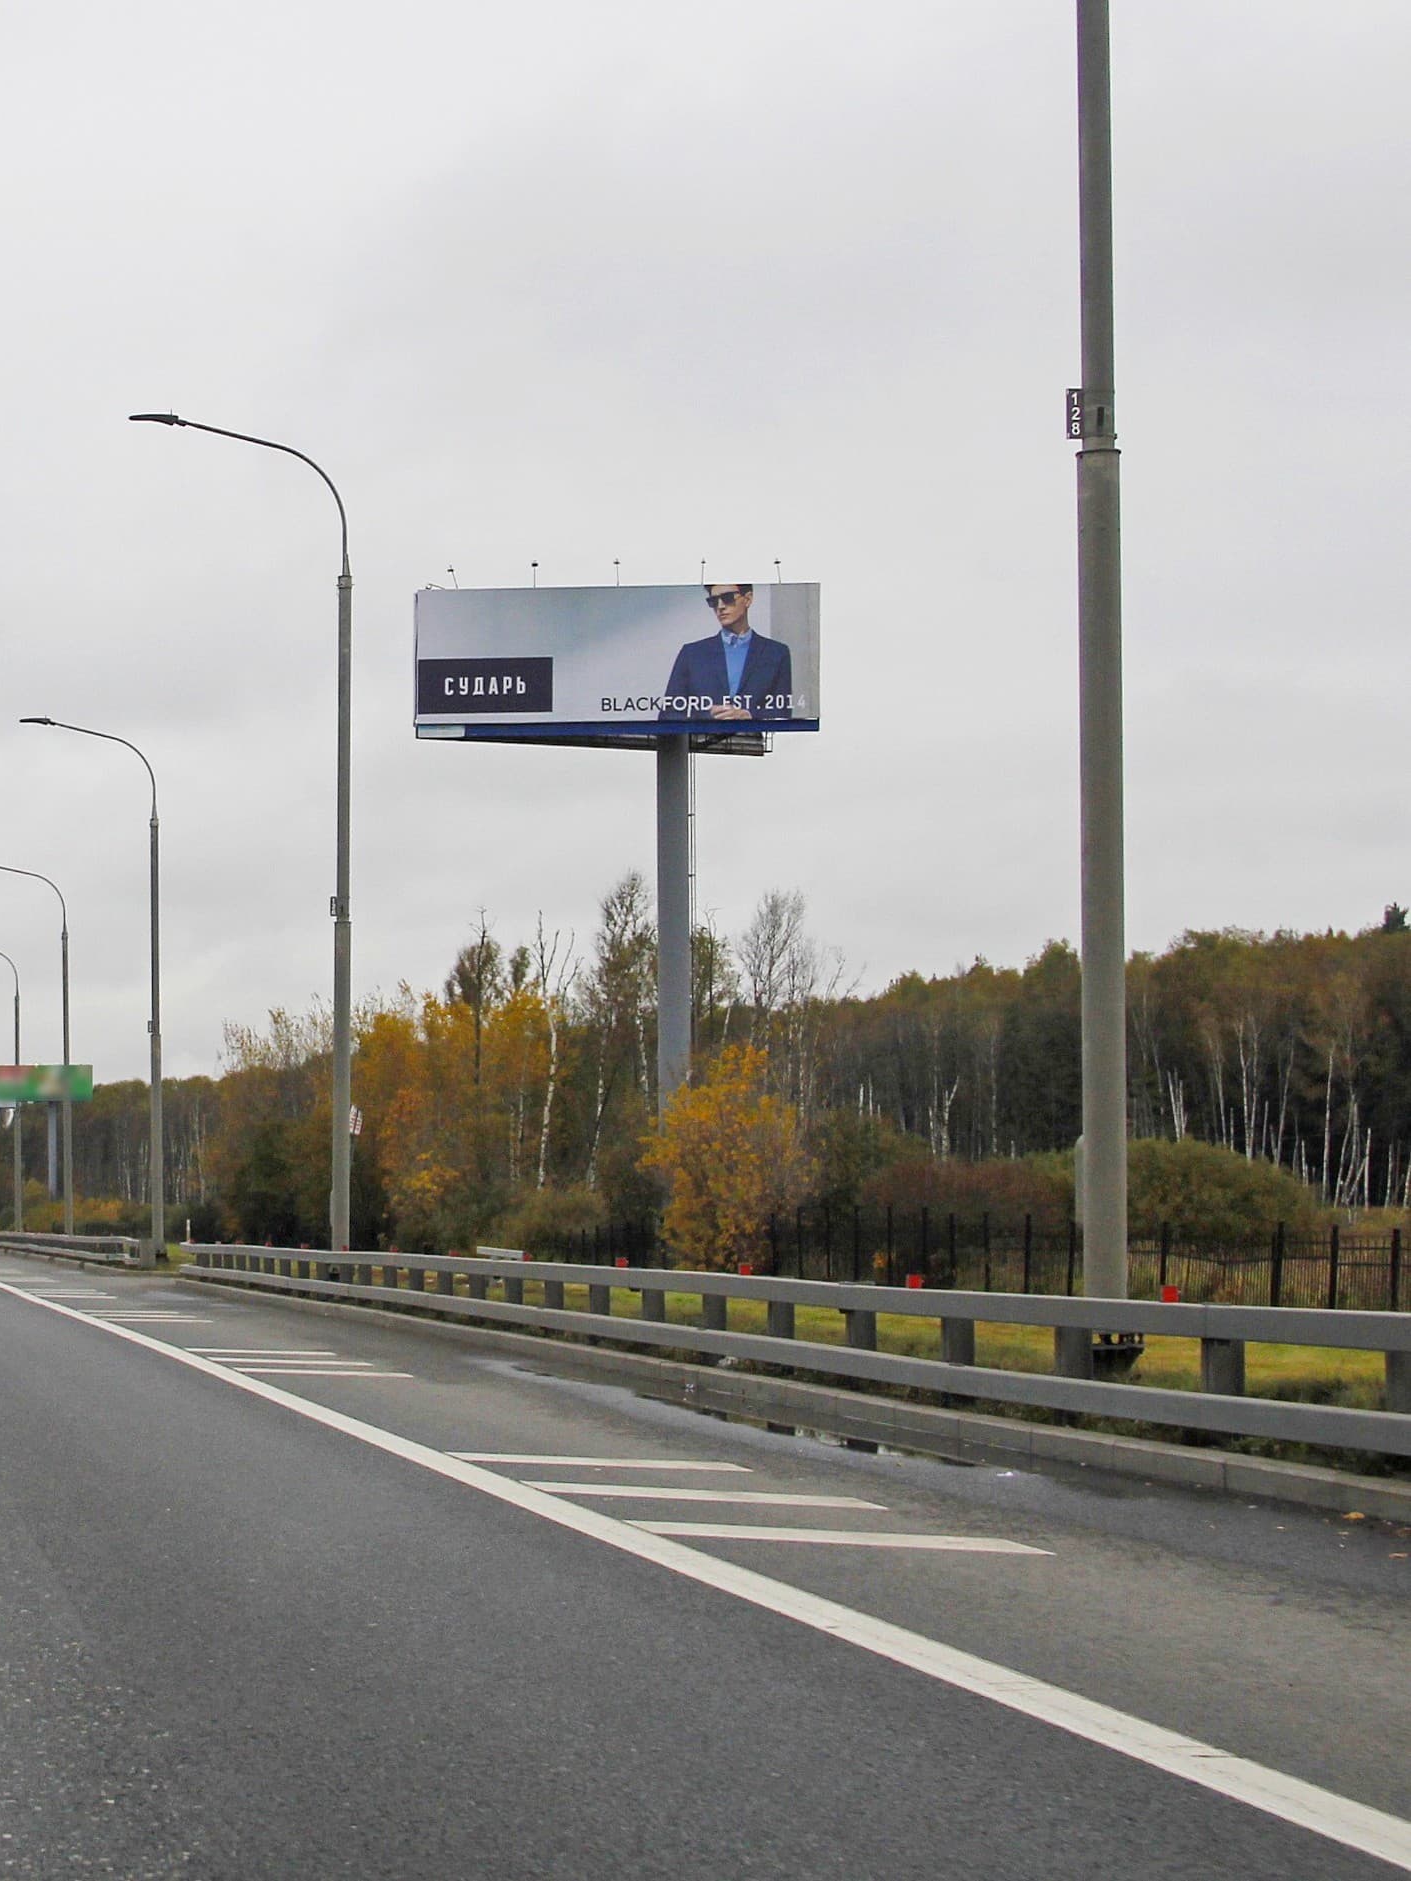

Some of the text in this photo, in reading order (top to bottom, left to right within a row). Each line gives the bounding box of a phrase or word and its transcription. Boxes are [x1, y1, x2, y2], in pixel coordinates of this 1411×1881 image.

[1071, 392, 1081, 435] 128
[444, 676, 527, 696] СУДАРЬ
[601, 695, 714, 718] BLACKFORD
